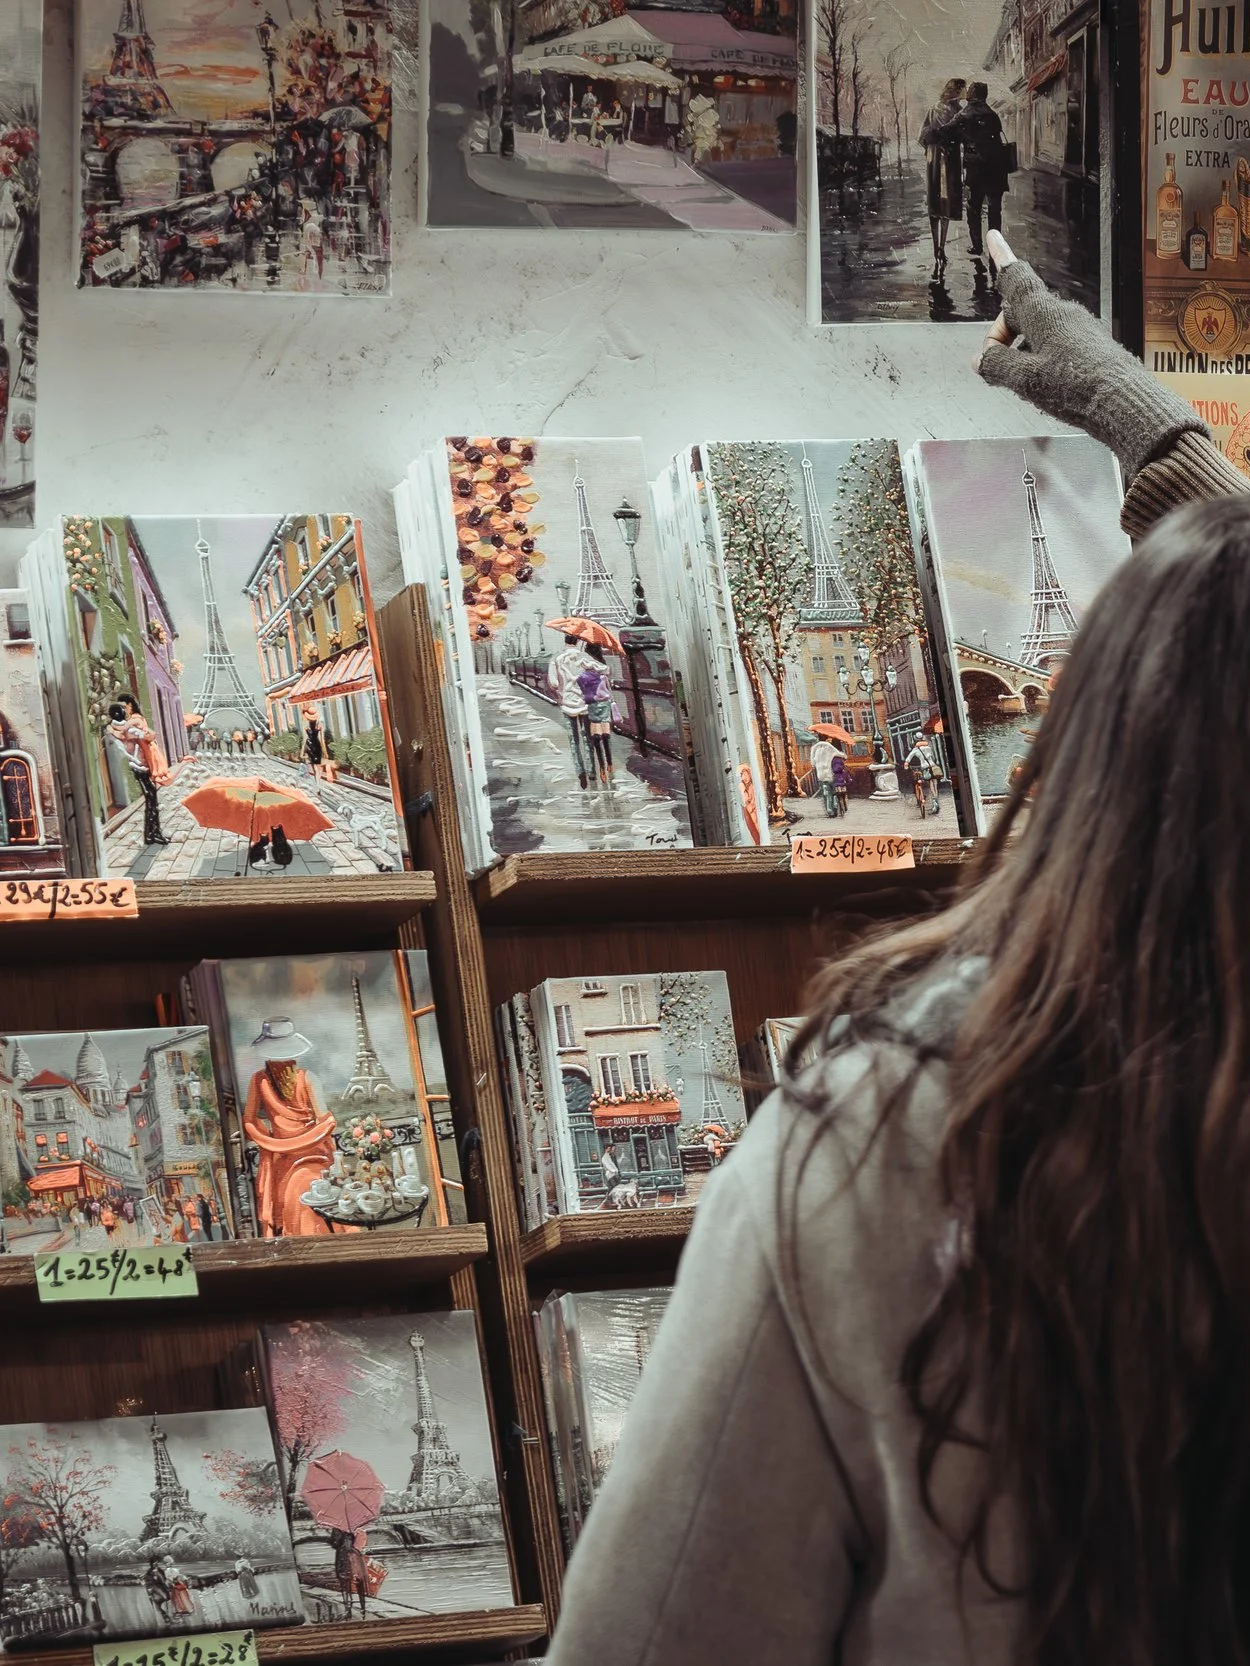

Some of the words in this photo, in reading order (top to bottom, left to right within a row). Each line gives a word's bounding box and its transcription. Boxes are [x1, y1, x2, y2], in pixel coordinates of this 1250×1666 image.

[1181, 78, 1250, 106] EAU
[1212, 108, 1224, 116] DE
[1153, 110, 1209, 146] Fleurs
[1185, 149, 1231, 169] EXTRA
